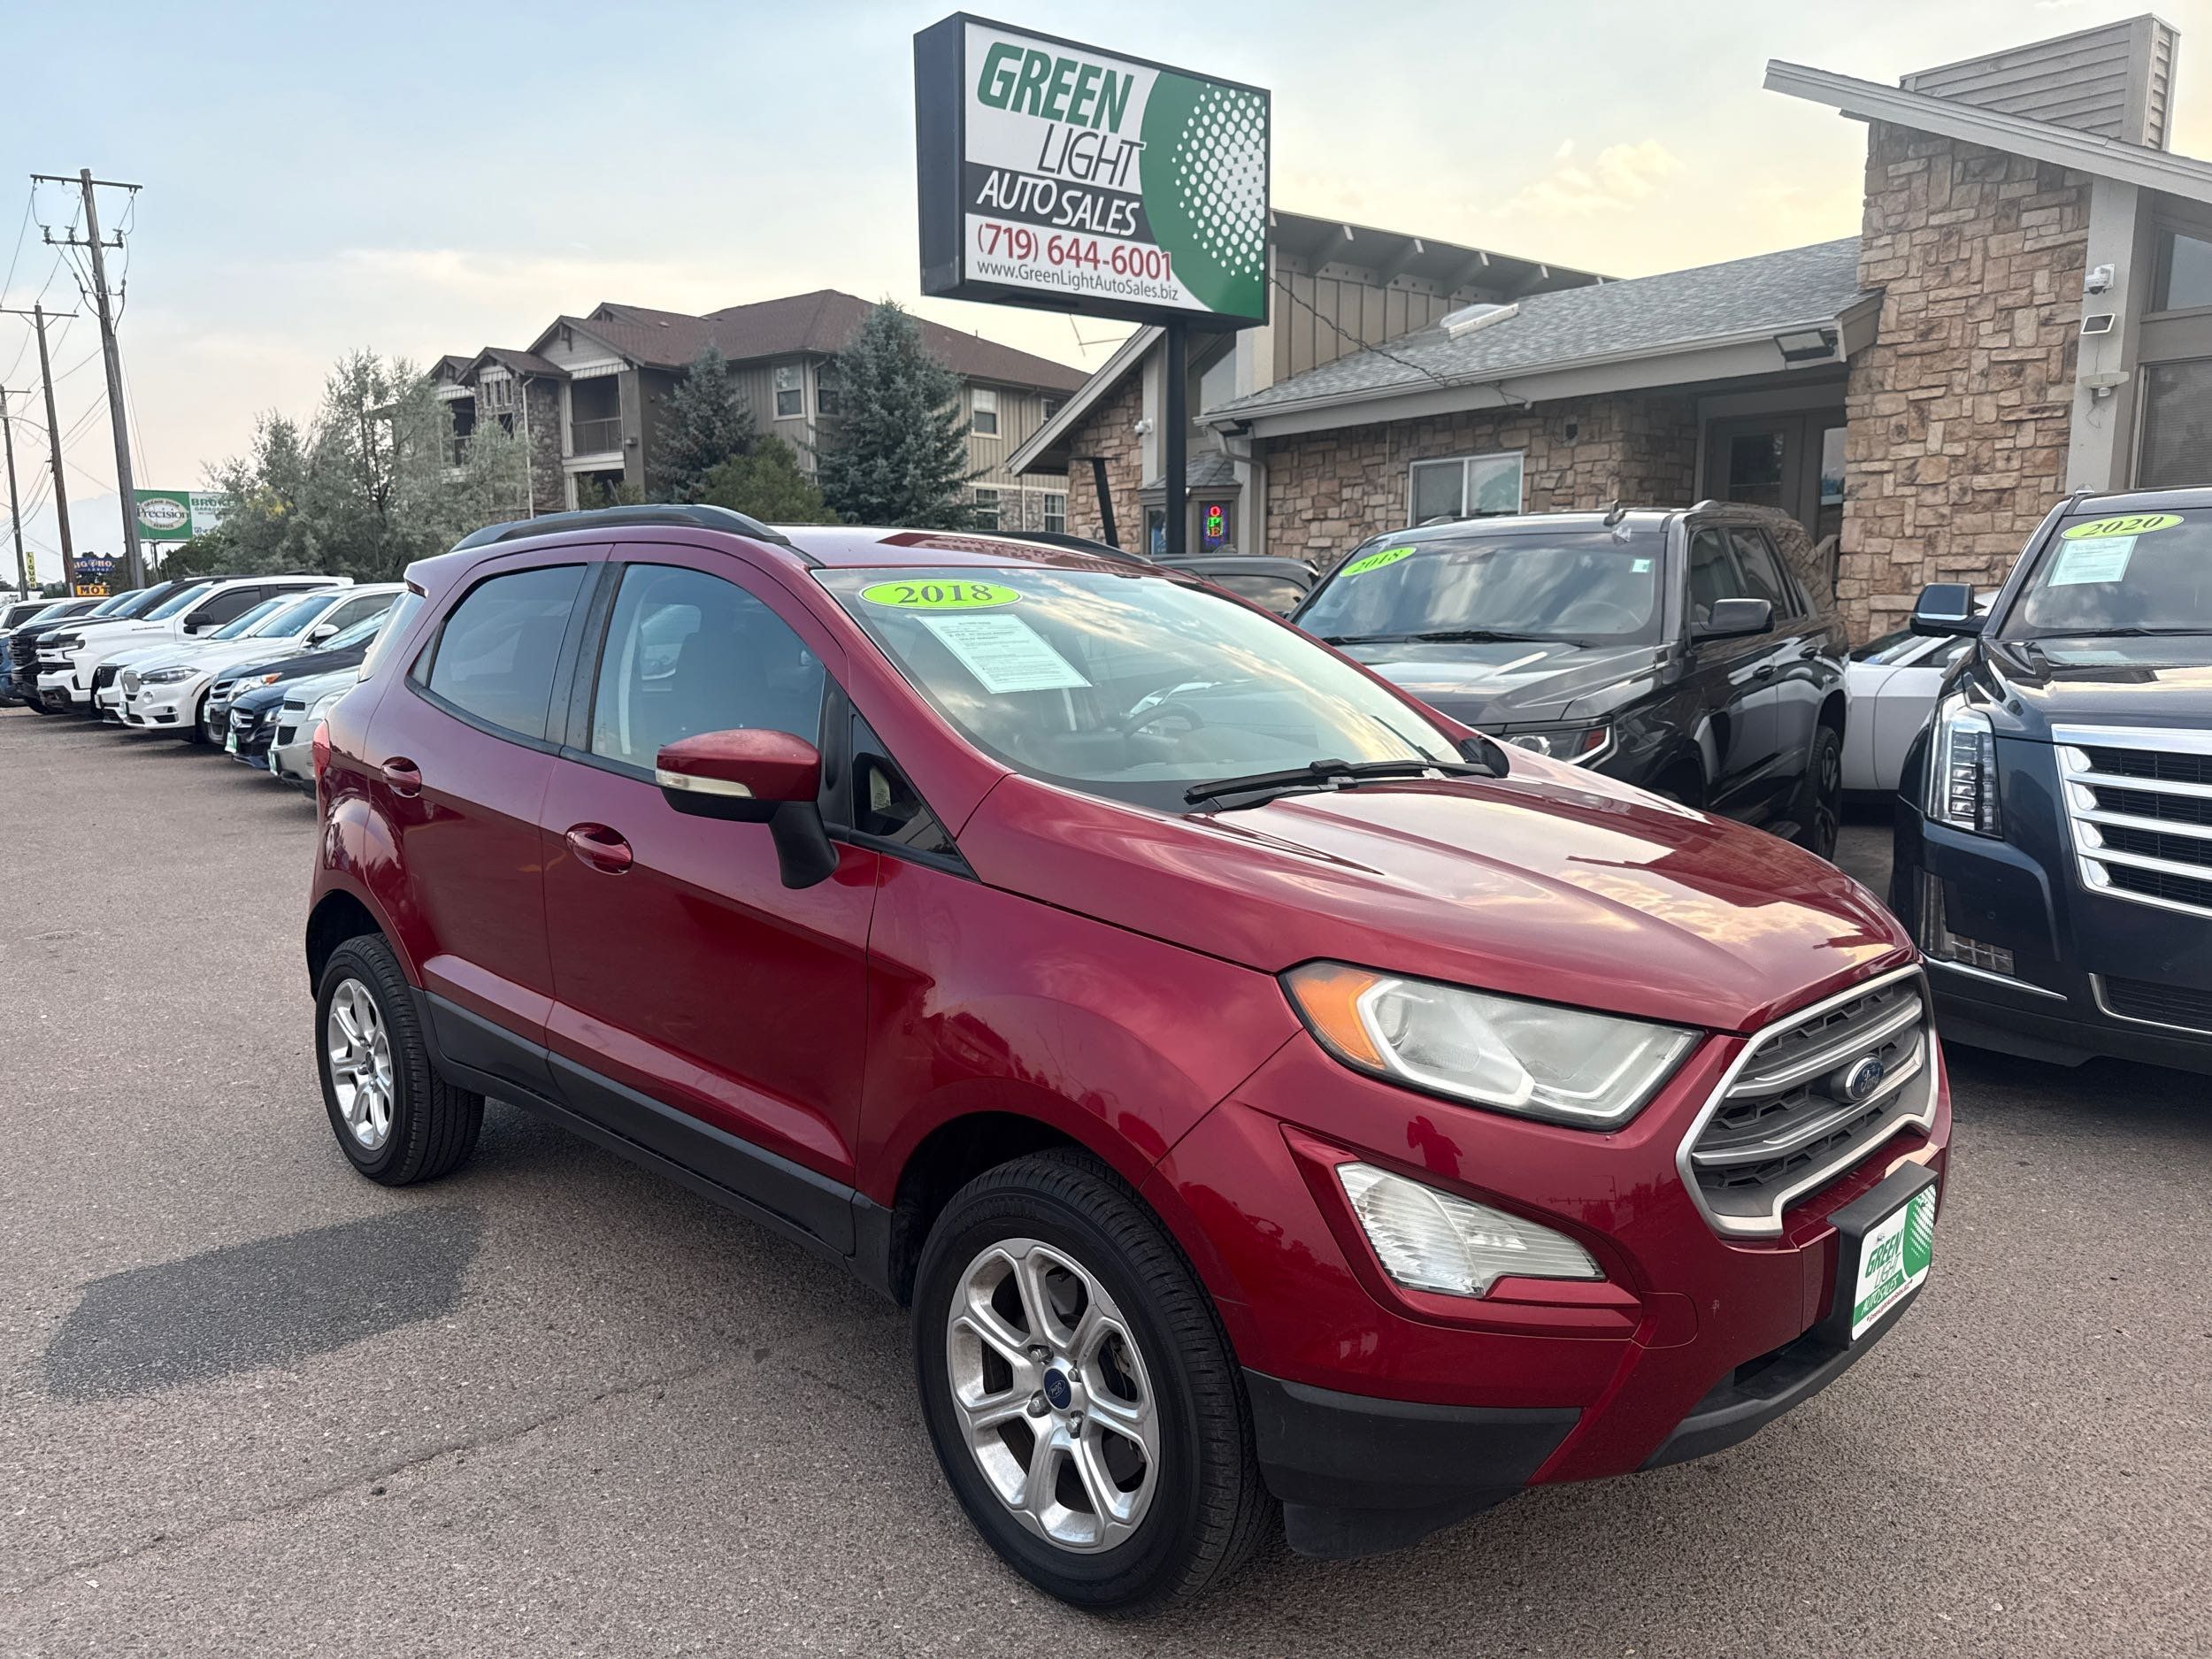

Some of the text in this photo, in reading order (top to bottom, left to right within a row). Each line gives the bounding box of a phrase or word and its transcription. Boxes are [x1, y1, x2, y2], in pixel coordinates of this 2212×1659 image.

[977, 42, 1134, 134] GREEN
[1037, 123, 1145, 187] LIGHT
[978, 223, 1171, 280] (719) 644-6001
[978, 260, 1179, 301] www.GreenLightAutoSales.biz
[136, 507, 189, 519] Precision
[2081, 516, 2164, 536] 2020
[27, 552, 36, 588] LIQUOR
[895, 584, 993, 603] 2018
[1865, 1228, 1903, 1279] GREEN
[1874, 1252, 1901, 1288] LIGHT
